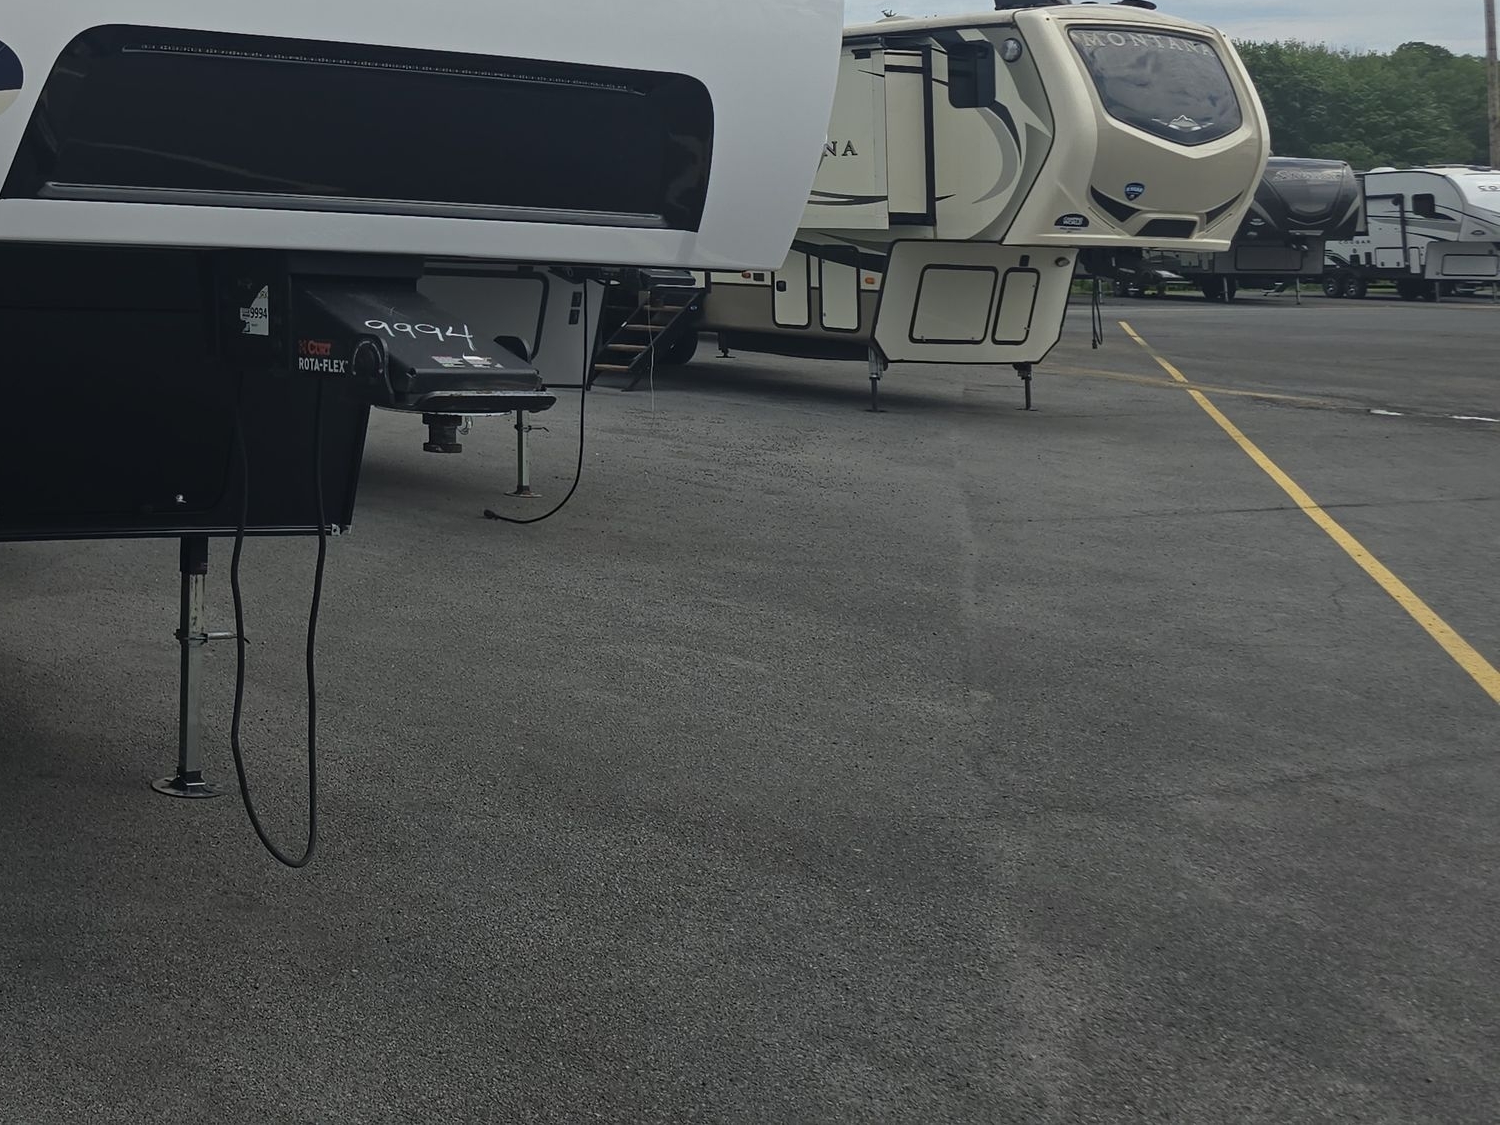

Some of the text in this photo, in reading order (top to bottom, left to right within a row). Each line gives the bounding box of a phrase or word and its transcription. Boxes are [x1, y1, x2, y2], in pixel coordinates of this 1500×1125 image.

[1081, 32, 1216, 58] MONTANA
[250, 307, 268, 319] 9994
[364, 319, 476, 351] 9994
